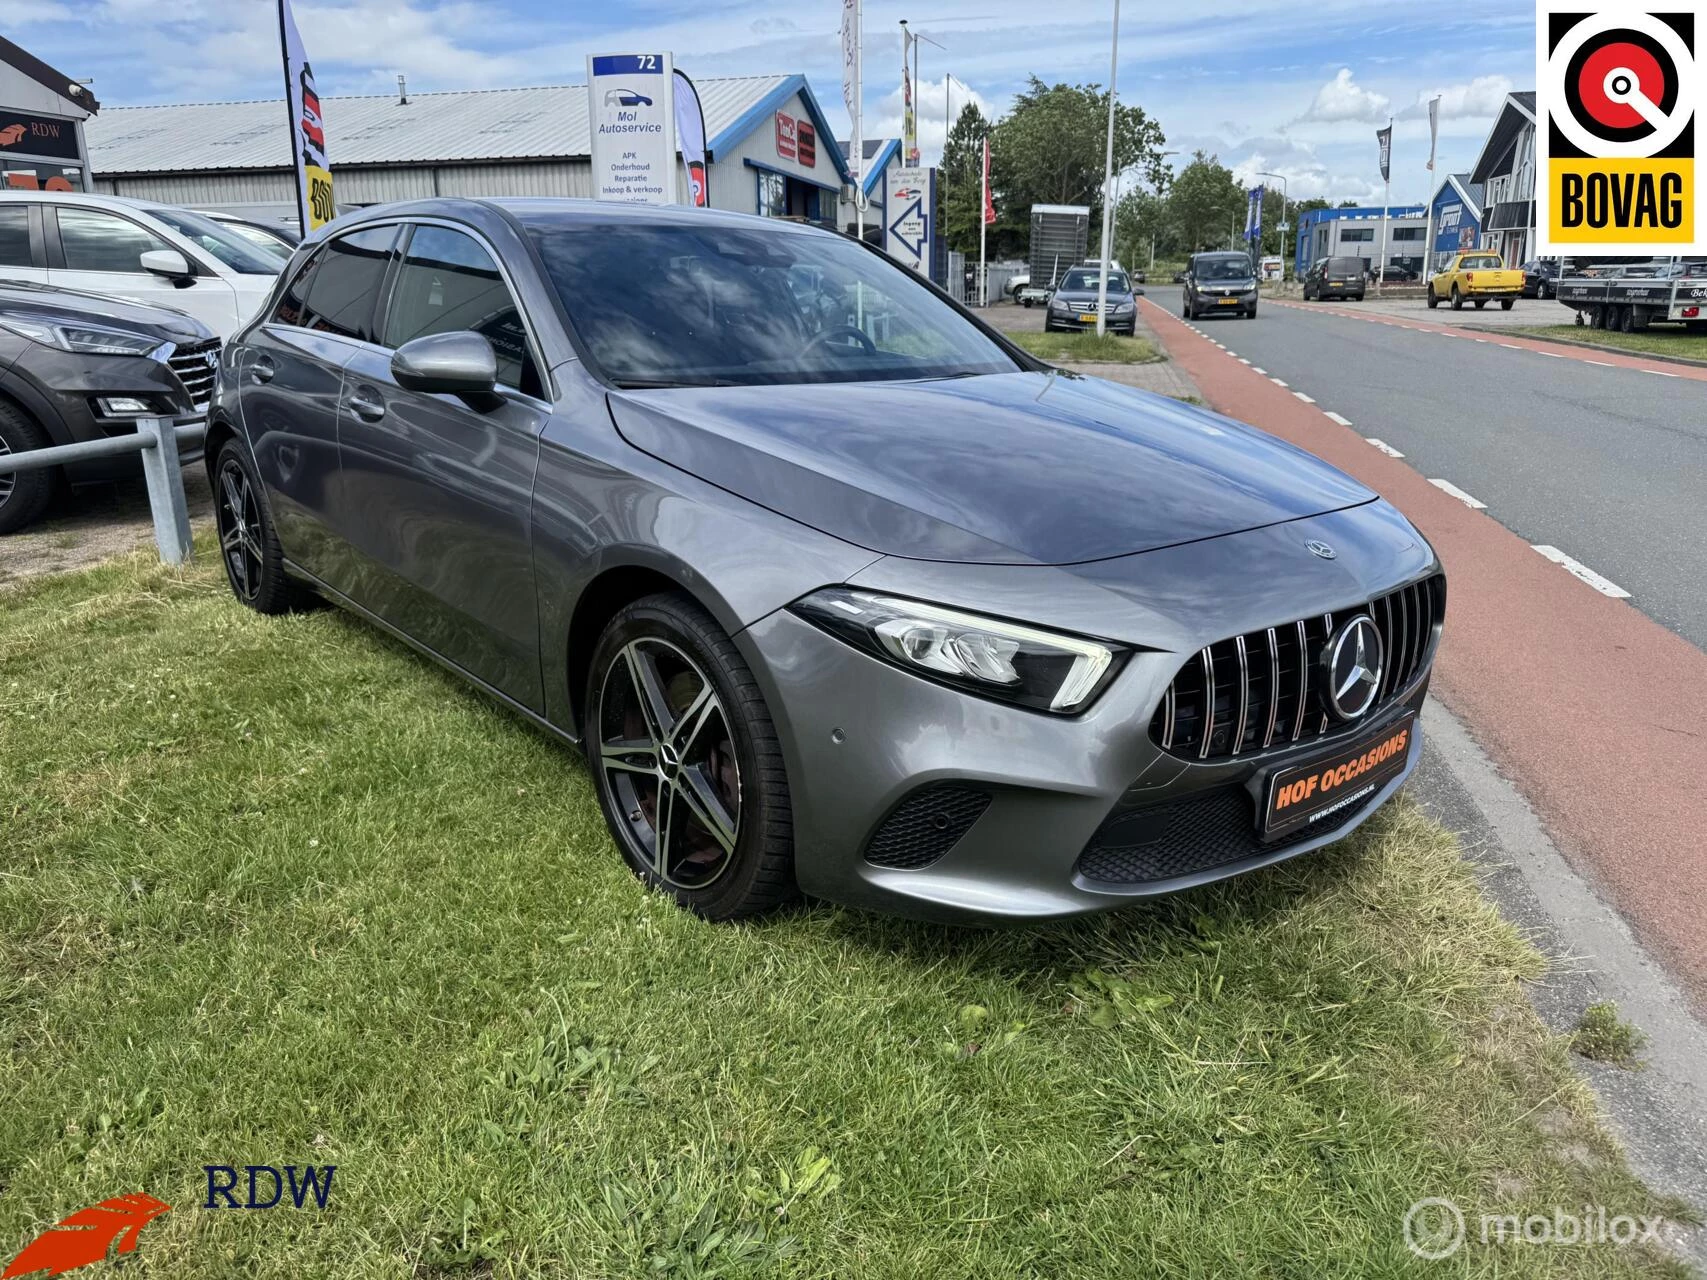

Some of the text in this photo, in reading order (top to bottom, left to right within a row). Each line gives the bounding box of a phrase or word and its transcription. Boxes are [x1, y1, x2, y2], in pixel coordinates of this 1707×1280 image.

[637, 55, 656, 70] 72
[617, 111, 637, 122] Mol
[31, 122, 60, 138] RDW
[598, 123, 662, 134] Autoservice
[622, 152, 637, 160] APK
[611, 163, 650, 171] Onderhoud
[614, 175, 648, 183] Reparatie
[602, 186, 625, 195] Inkoop
[633, 186, 663, 195] verkoop
[1276, 729, 1407, 810] HOF OCCASIONS
[1309, 783, 1376, 823] WWW.HOFOCCASIONS.NL
